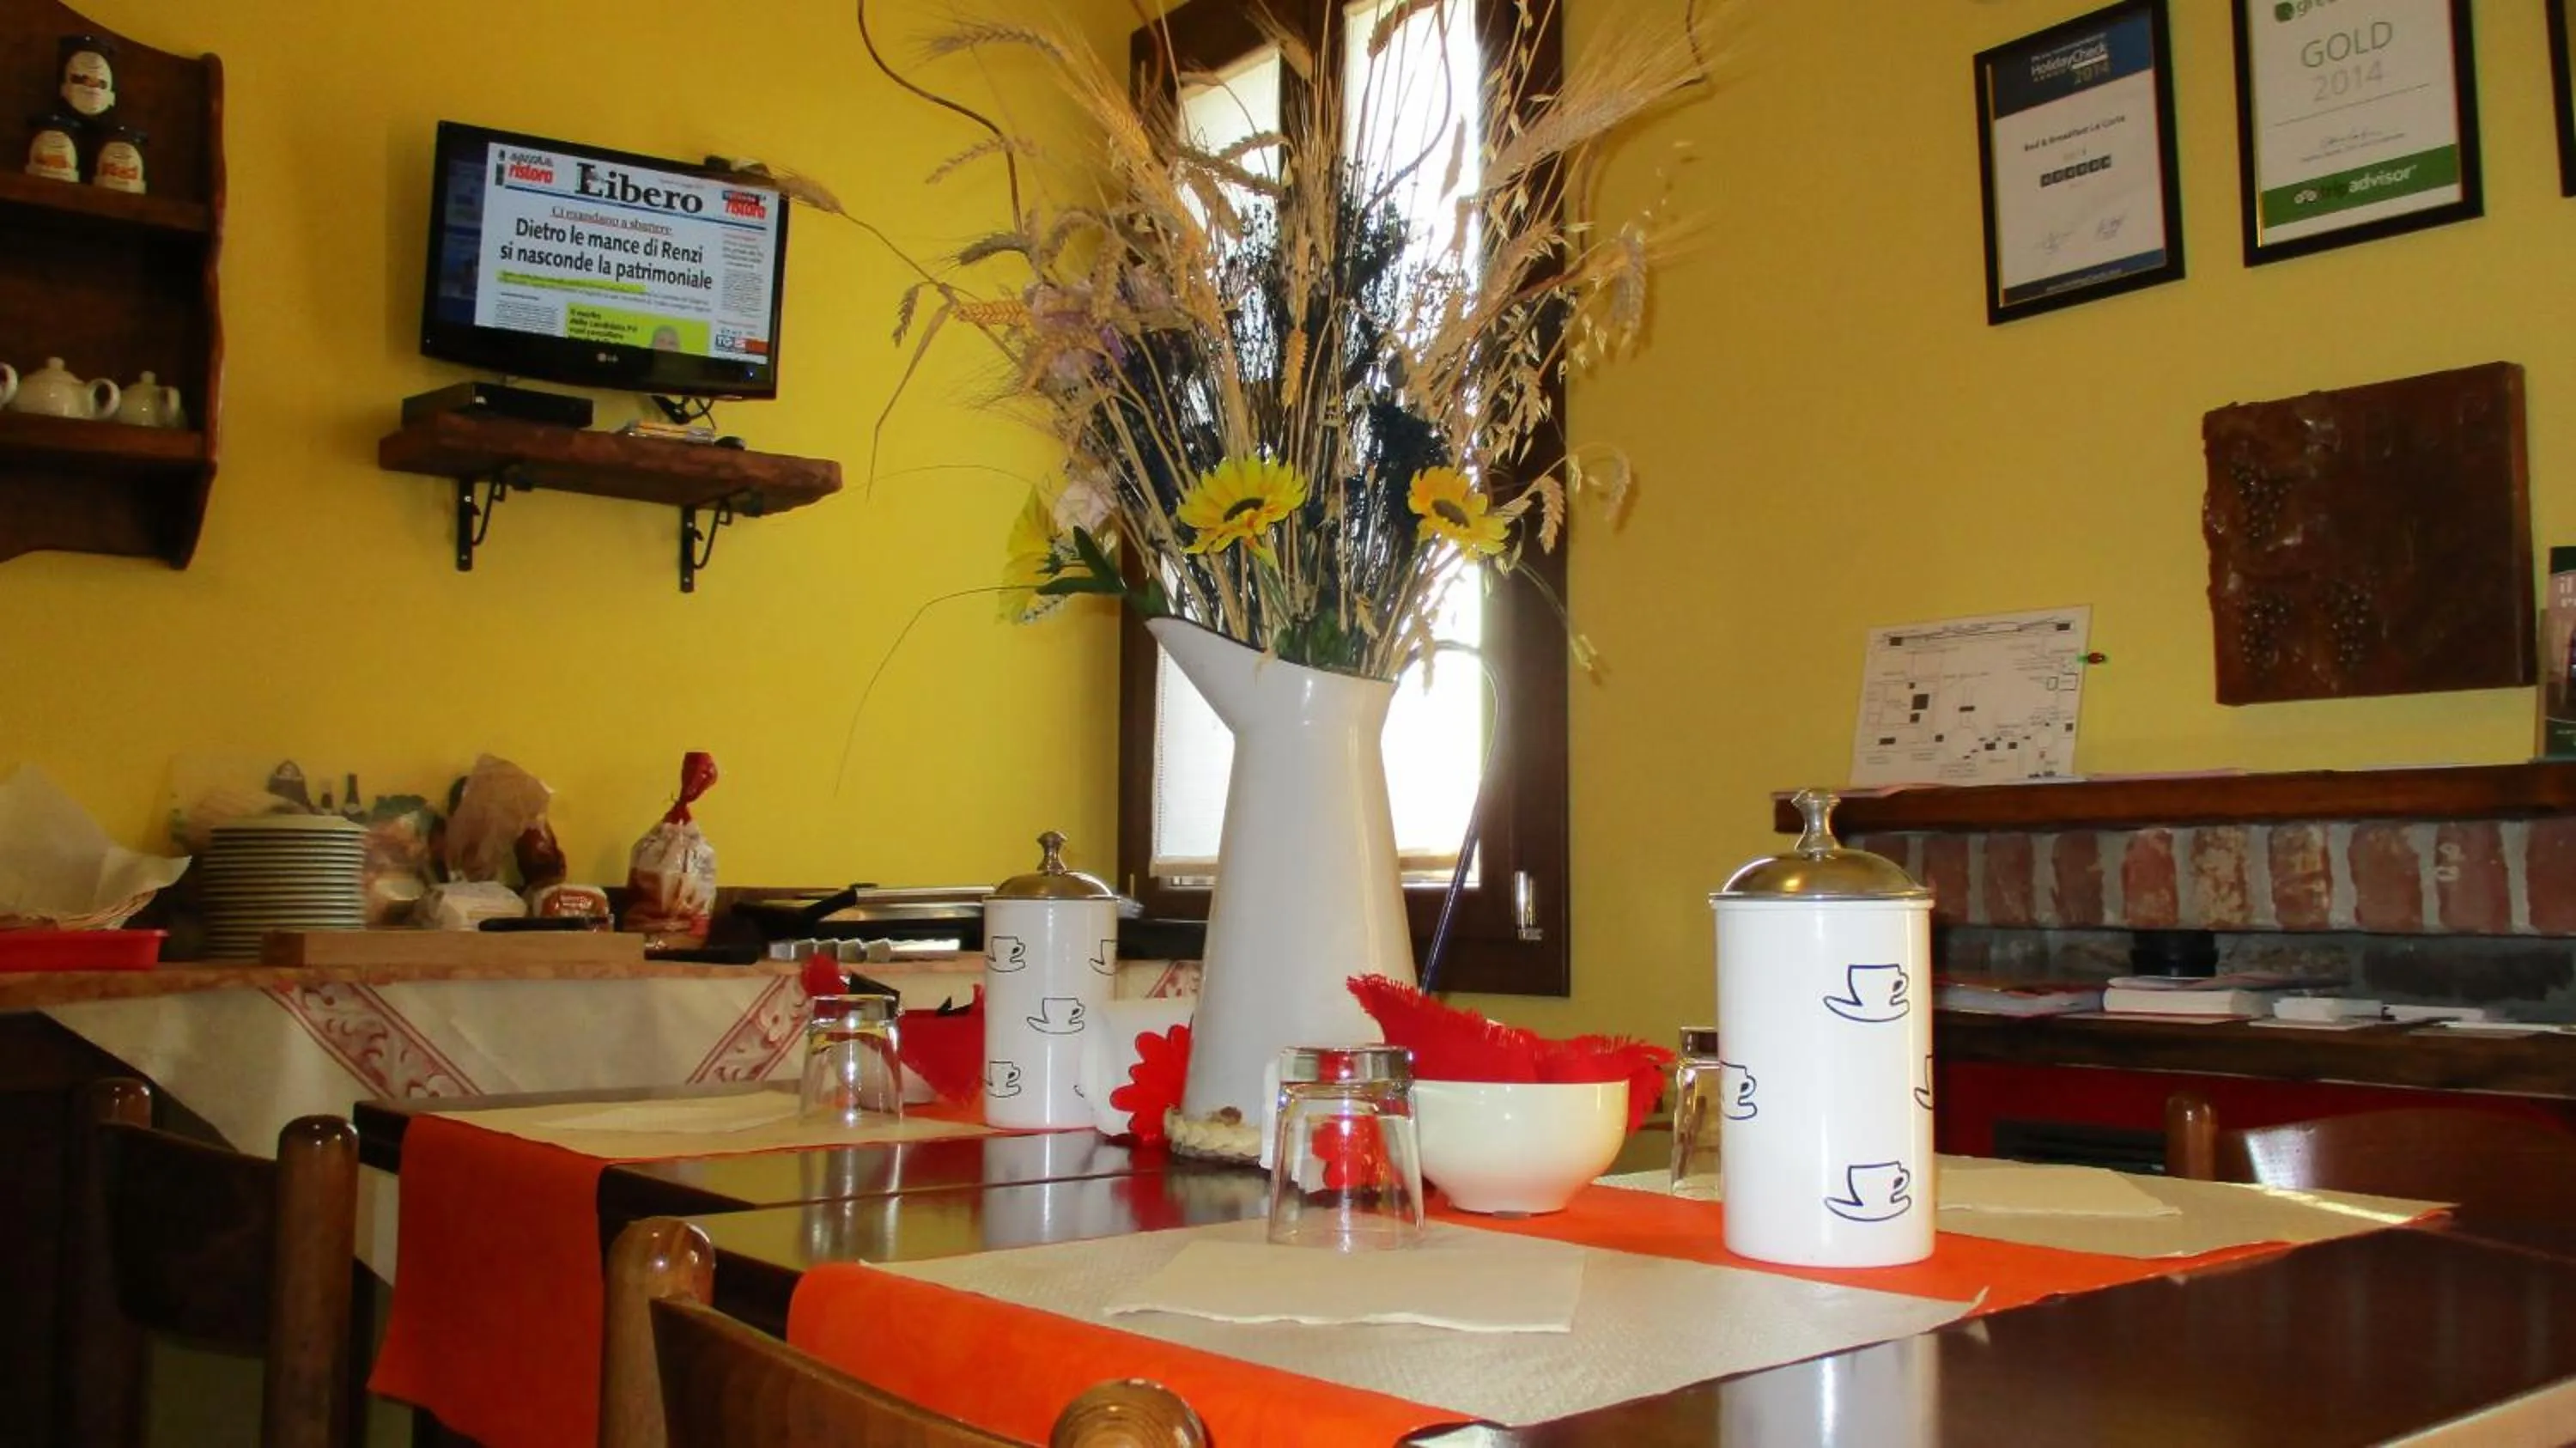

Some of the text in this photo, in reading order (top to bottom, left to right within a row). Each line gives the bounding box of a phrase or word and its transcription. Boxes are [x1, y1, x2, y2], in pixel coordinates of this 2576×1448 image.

[2301, 21, 2393, 68] GOLD
[2312, 58, 2384, 102] 2014
[574, 162, 703, 213] Libero
[516, 217, 566, 243] Dietro
[570, 225, 585, 246] le
[588, 233, 640, 254] mance
[644, 239, 659, 257] di
[662, 241, 703, 264] Renzi
[500, 241, 712, 289] si nasconde la patrimoniale
